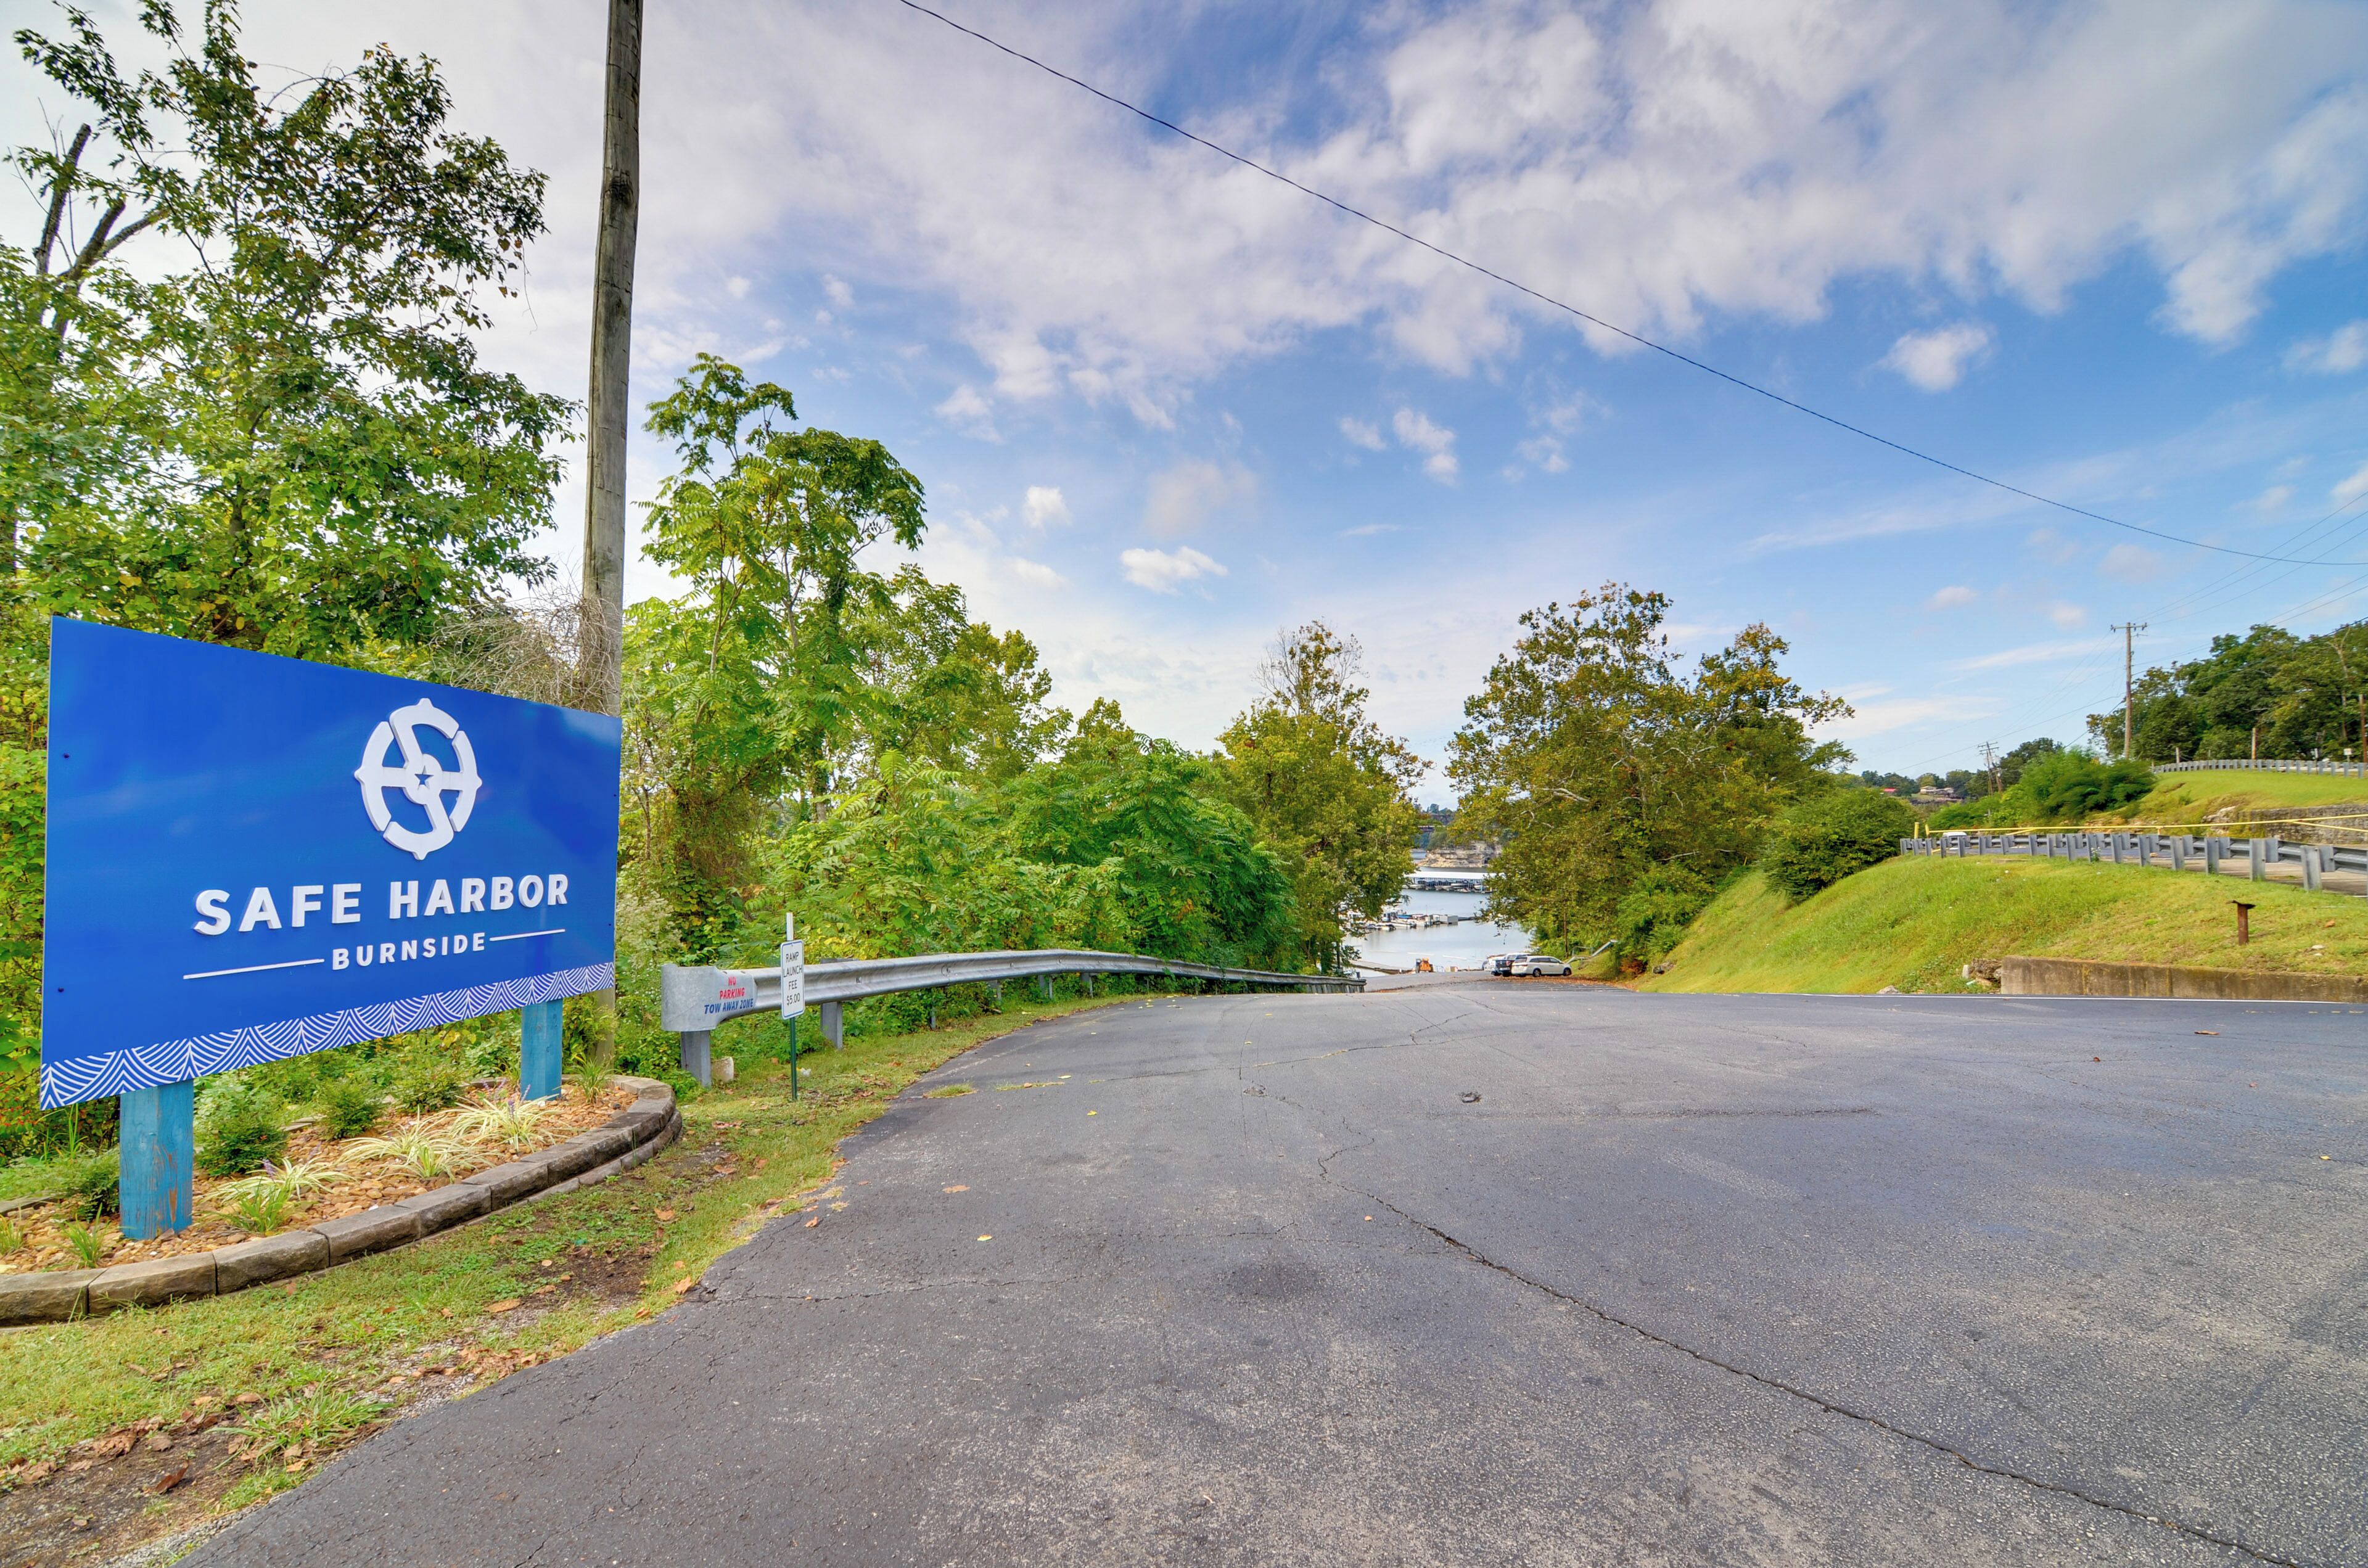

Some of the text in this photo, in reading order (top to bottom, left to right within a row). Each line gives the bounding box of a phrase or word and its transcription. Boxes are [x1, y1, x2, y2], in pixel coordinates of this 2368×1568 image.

[193, 874, 569, 936] SAFE HARBOR
[332, 932, 486, 971] BURNSIDE
[786, 951, 799, 963] RAMP
[783, 965, 802, 977] LAUNCH
[728, 976, 736, 986] NO
[789, 980, 797, 990] FEE
[720, 987, 745, 999] PARKING
[786, 993, 800, 1006] $5.00
[704, 998, 754, 1014] TOW AWAY ZONE
